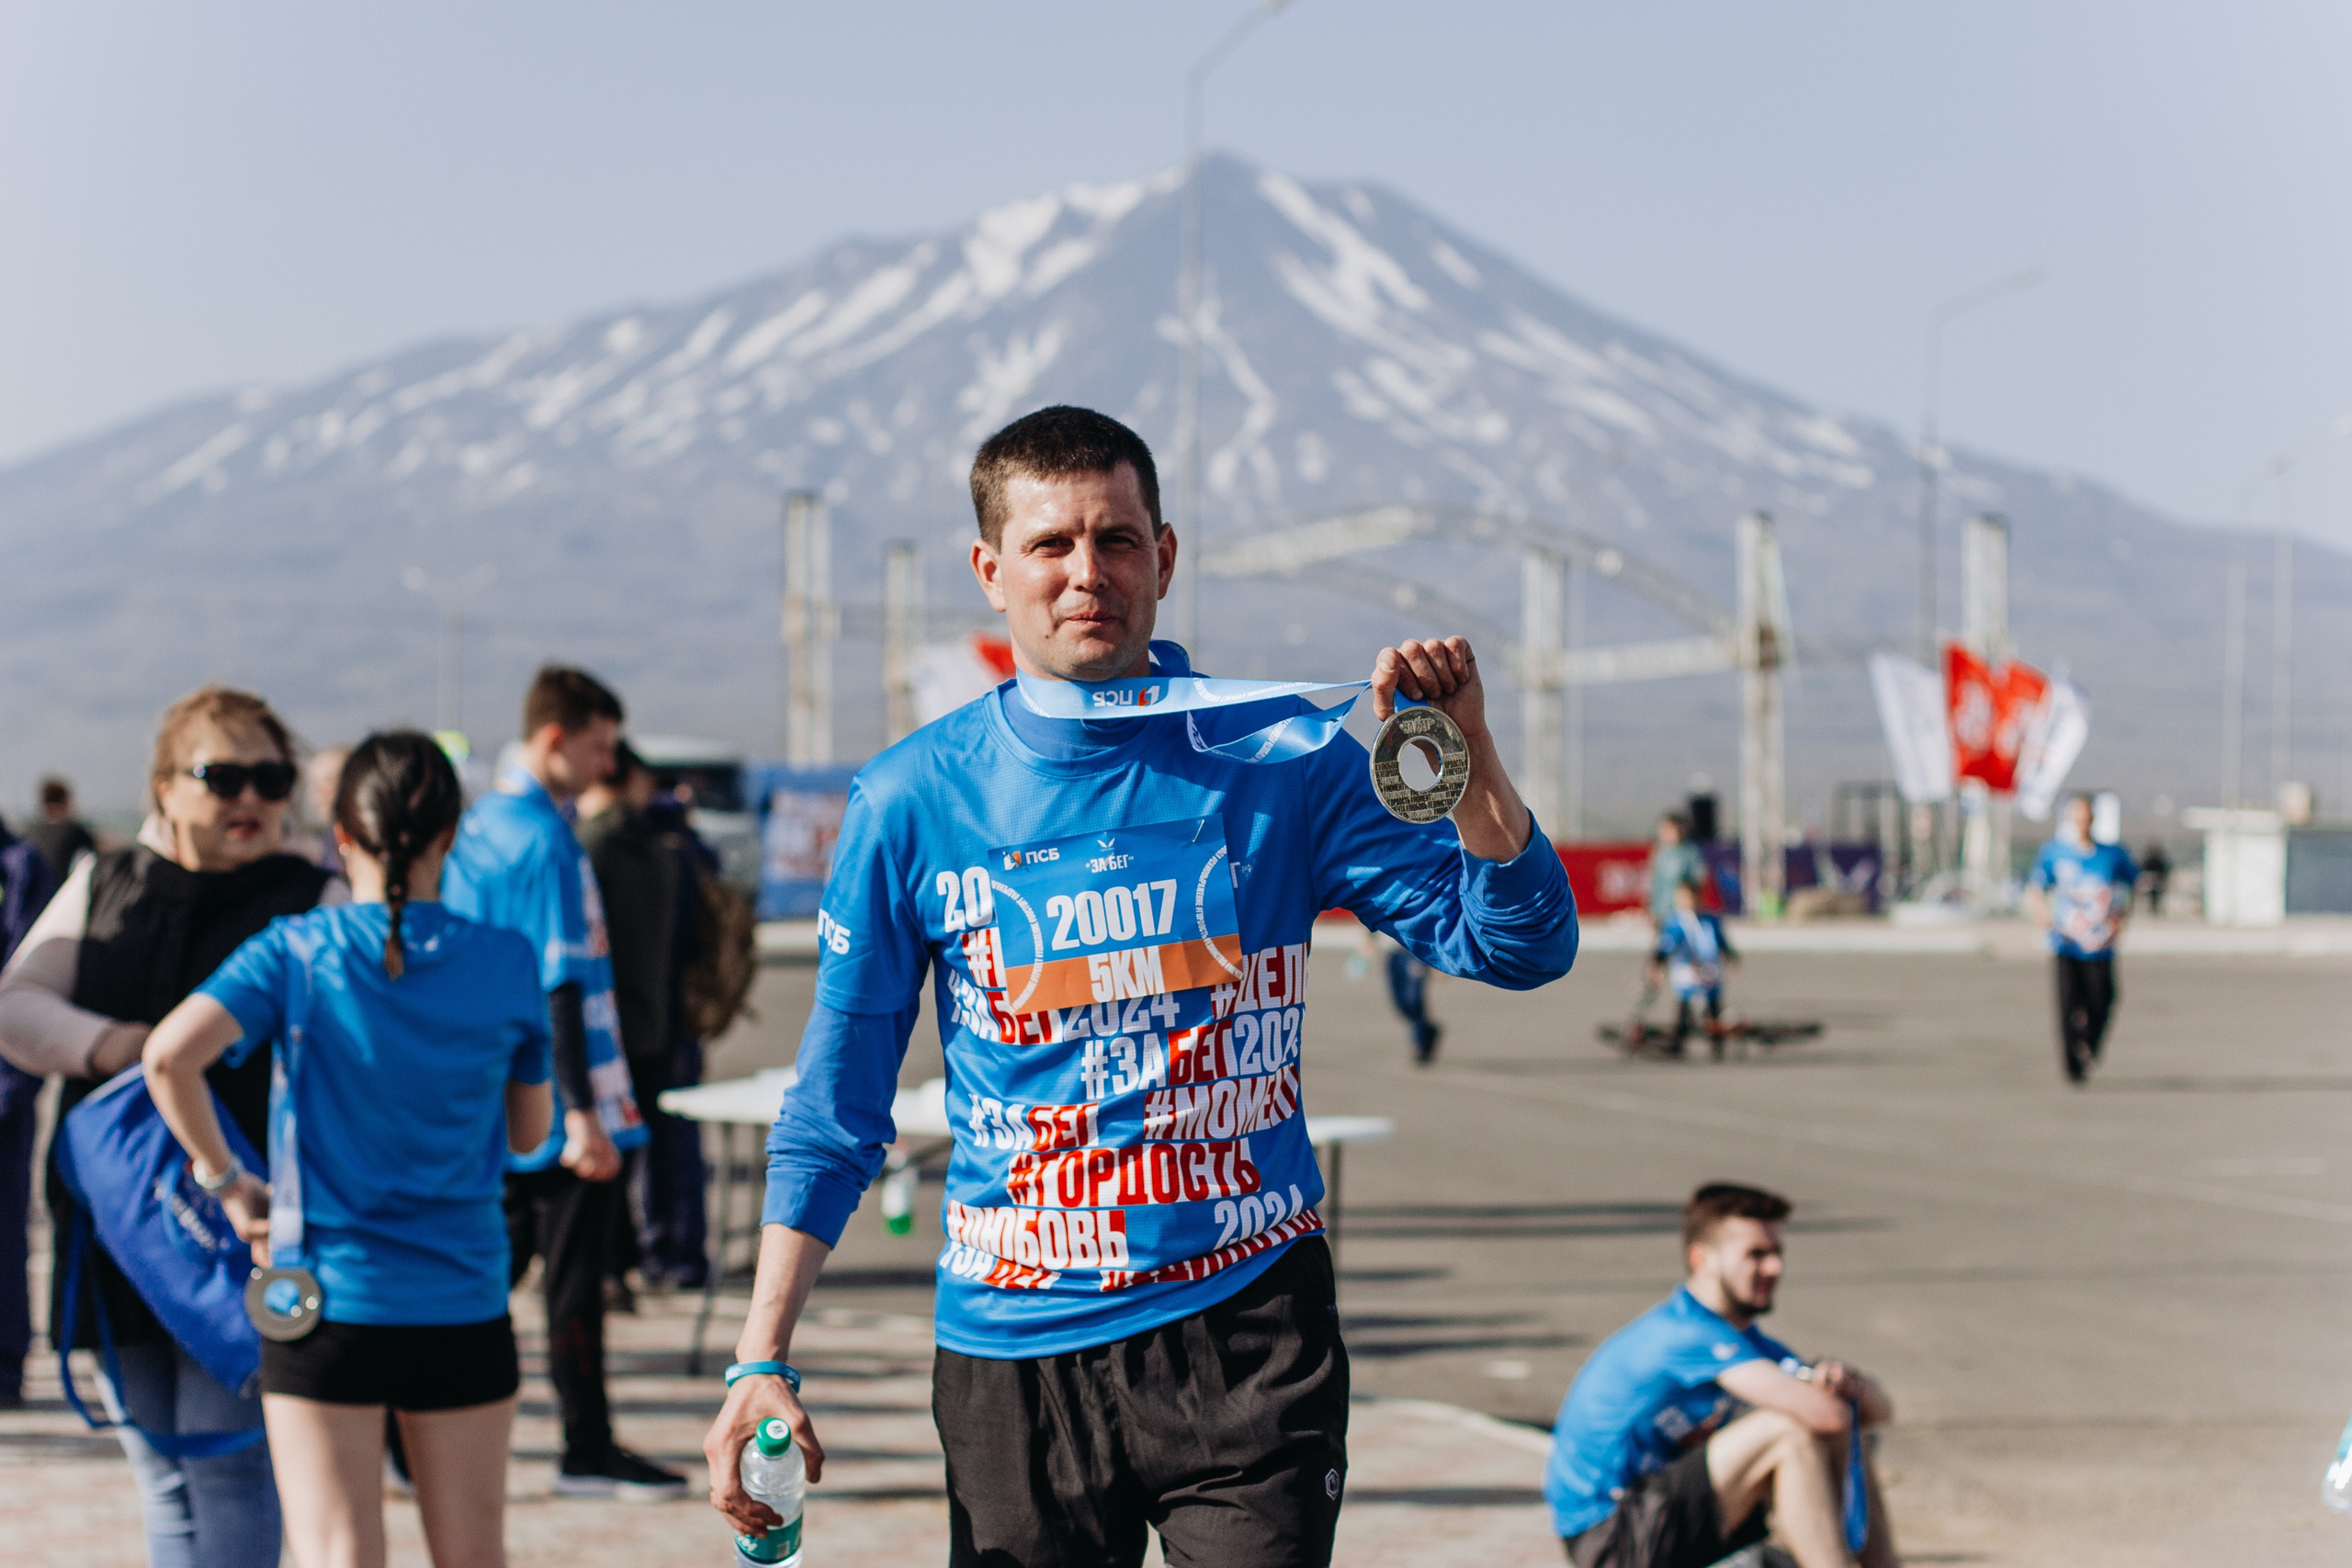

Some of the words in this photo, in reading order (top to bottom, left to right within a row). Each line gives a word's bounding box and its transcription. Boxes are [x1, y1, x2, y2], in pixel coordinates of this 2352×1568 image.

[1093, 690, 1132, 706] ПСБ
[1025, 848, 1060, 864] ПСБ
[1046, 878, 1177, 952] 20017
[968, 1094, 1099, 1152] #ЗАБЕГ
[1008, 1139, 1261, 1208] #ГОРДОСТЬ
[947, 1200, 1129, 1270] #ЛЮБОВЬ
